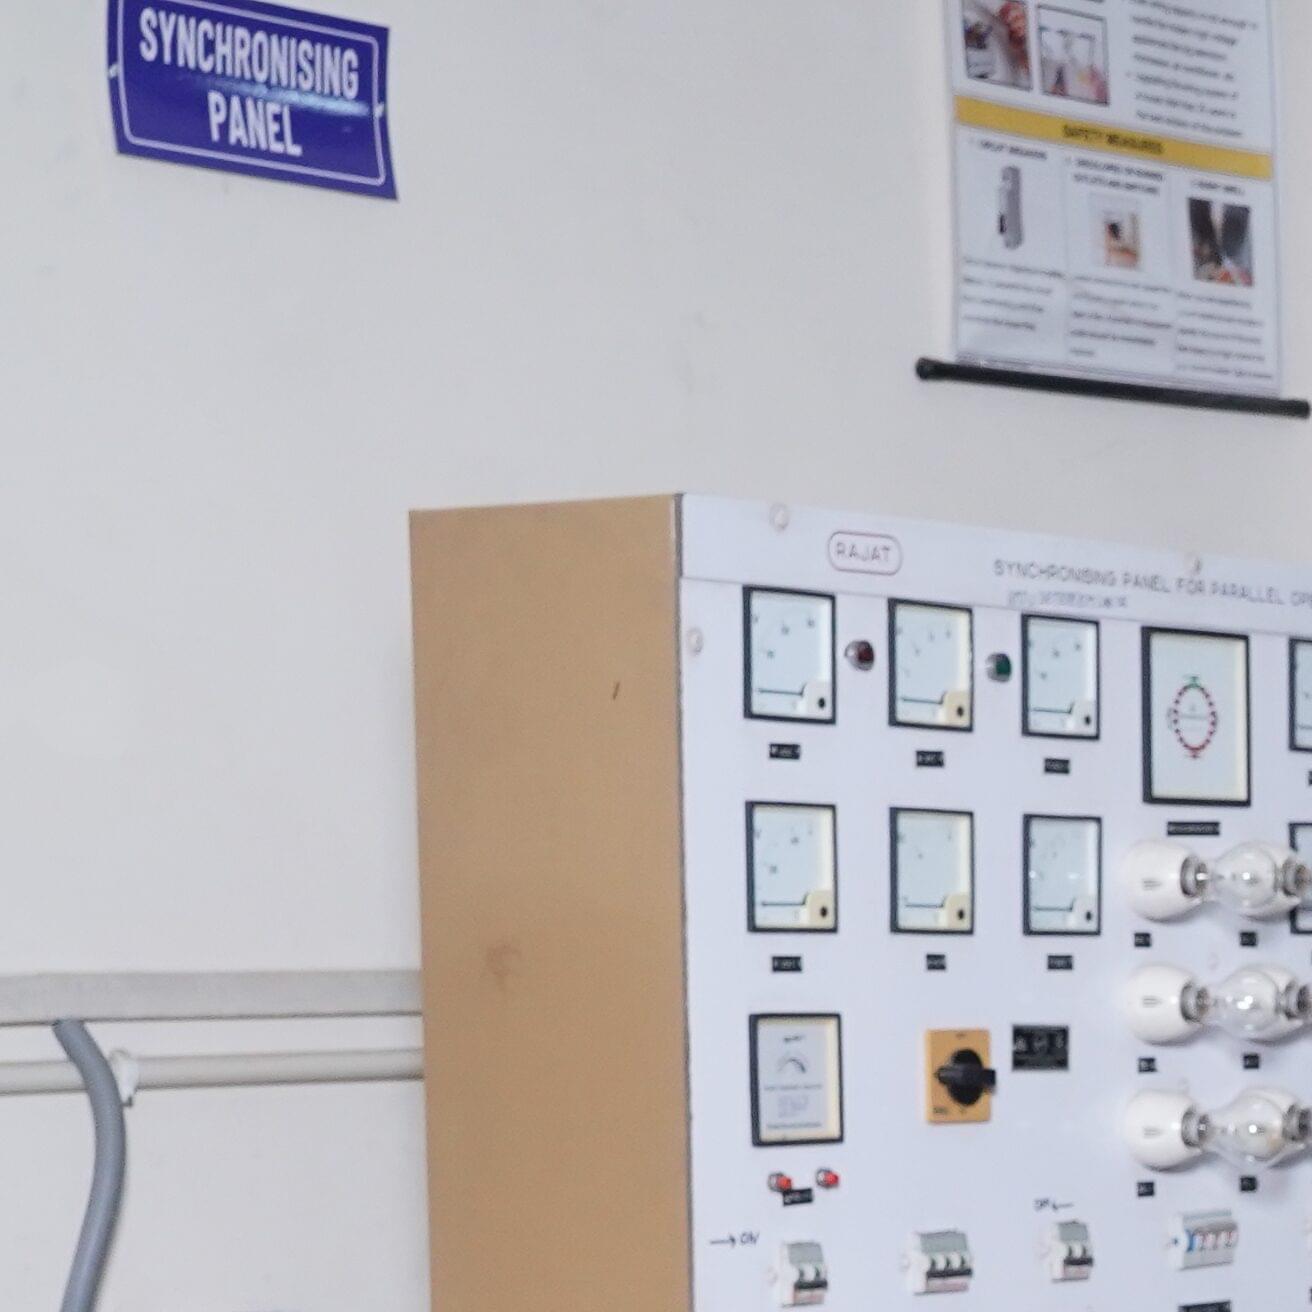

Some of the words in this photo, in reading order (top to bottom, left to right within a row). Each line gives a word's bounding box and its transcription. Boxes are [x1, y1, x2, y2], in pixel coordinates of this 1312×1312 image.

[139, 6, 359, 101] SYNCHRONISING
[207, 90, 303, 157] PANEL
[836, 542, 891, 562] RAJAT
[1122, 569, 1171, 594] PANEL
